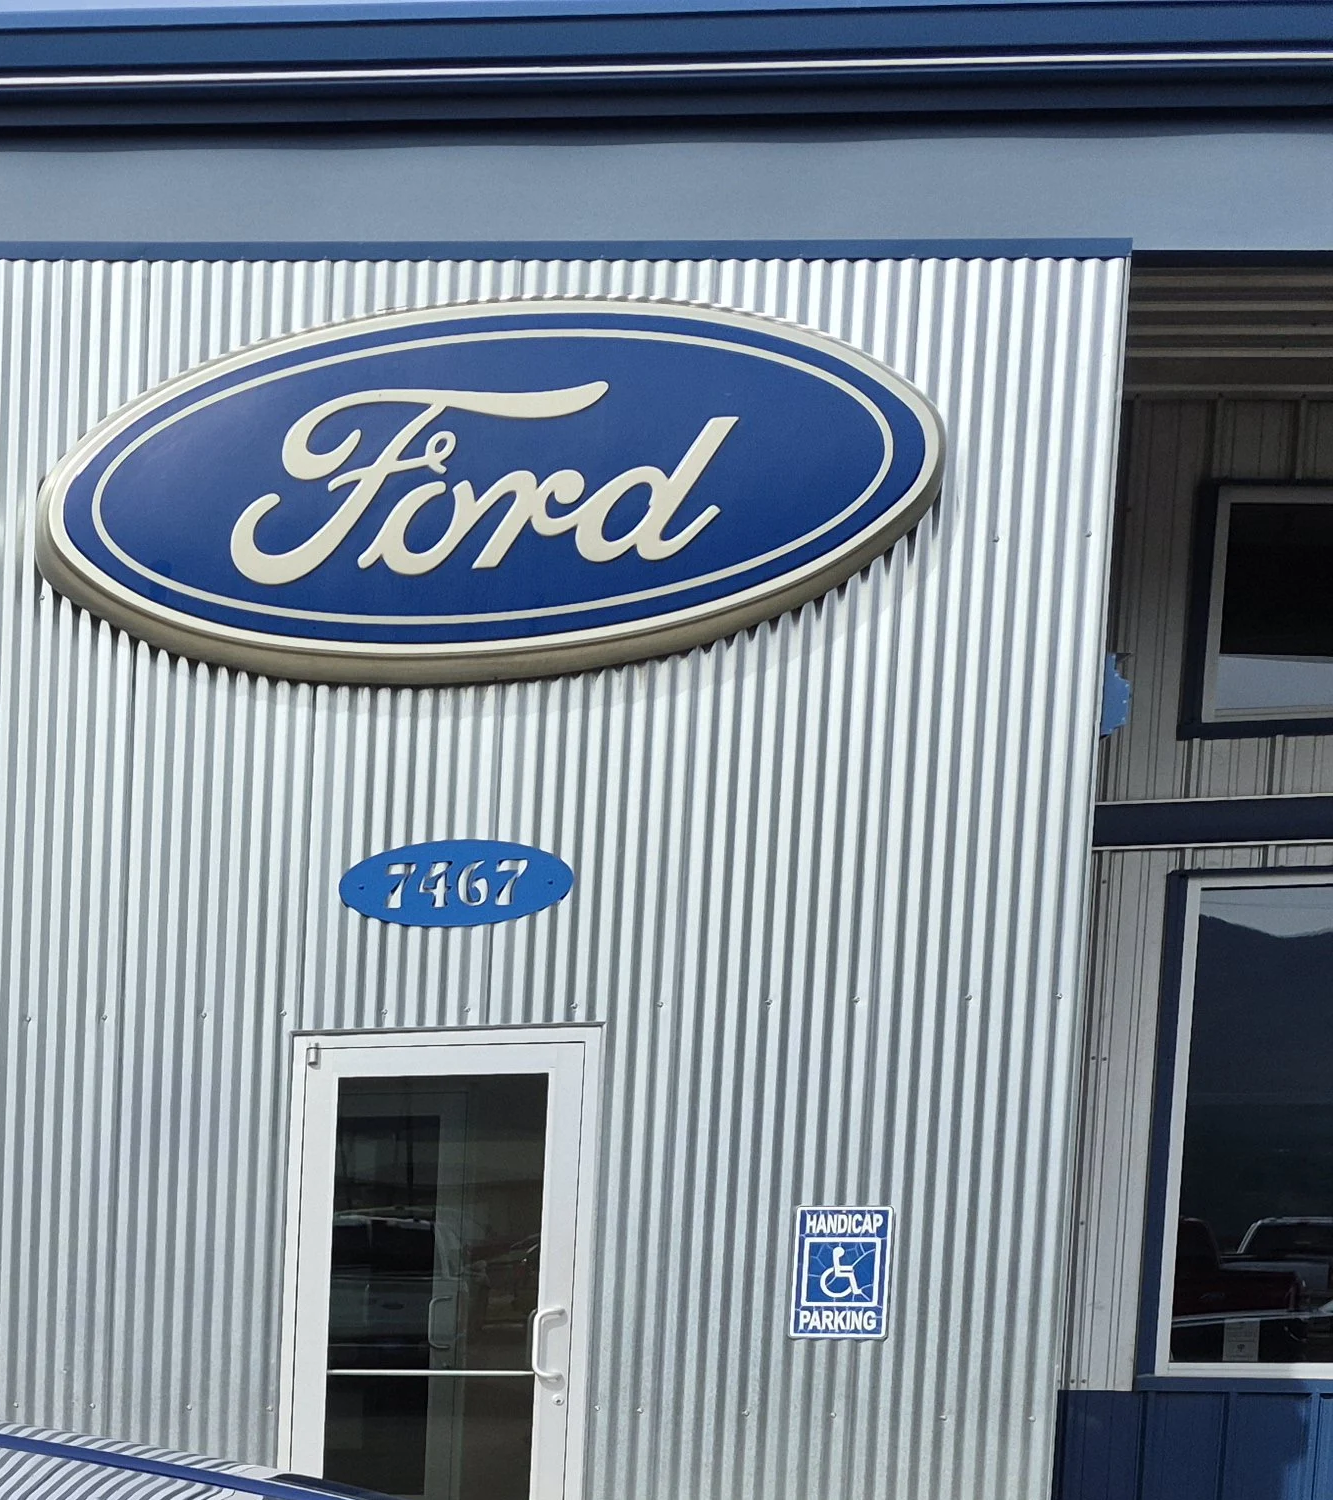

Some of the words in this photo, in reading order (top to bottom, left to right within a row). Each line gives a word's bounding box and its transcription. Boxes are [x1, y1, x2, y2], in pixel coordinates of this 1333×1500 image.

[230, 380, 738, 586] Ford
[386, 858, 529, 909] 7467
[805, 1213, 883, 1235] HANDICAP
[798, 1310, 876, 1332] PARKING
